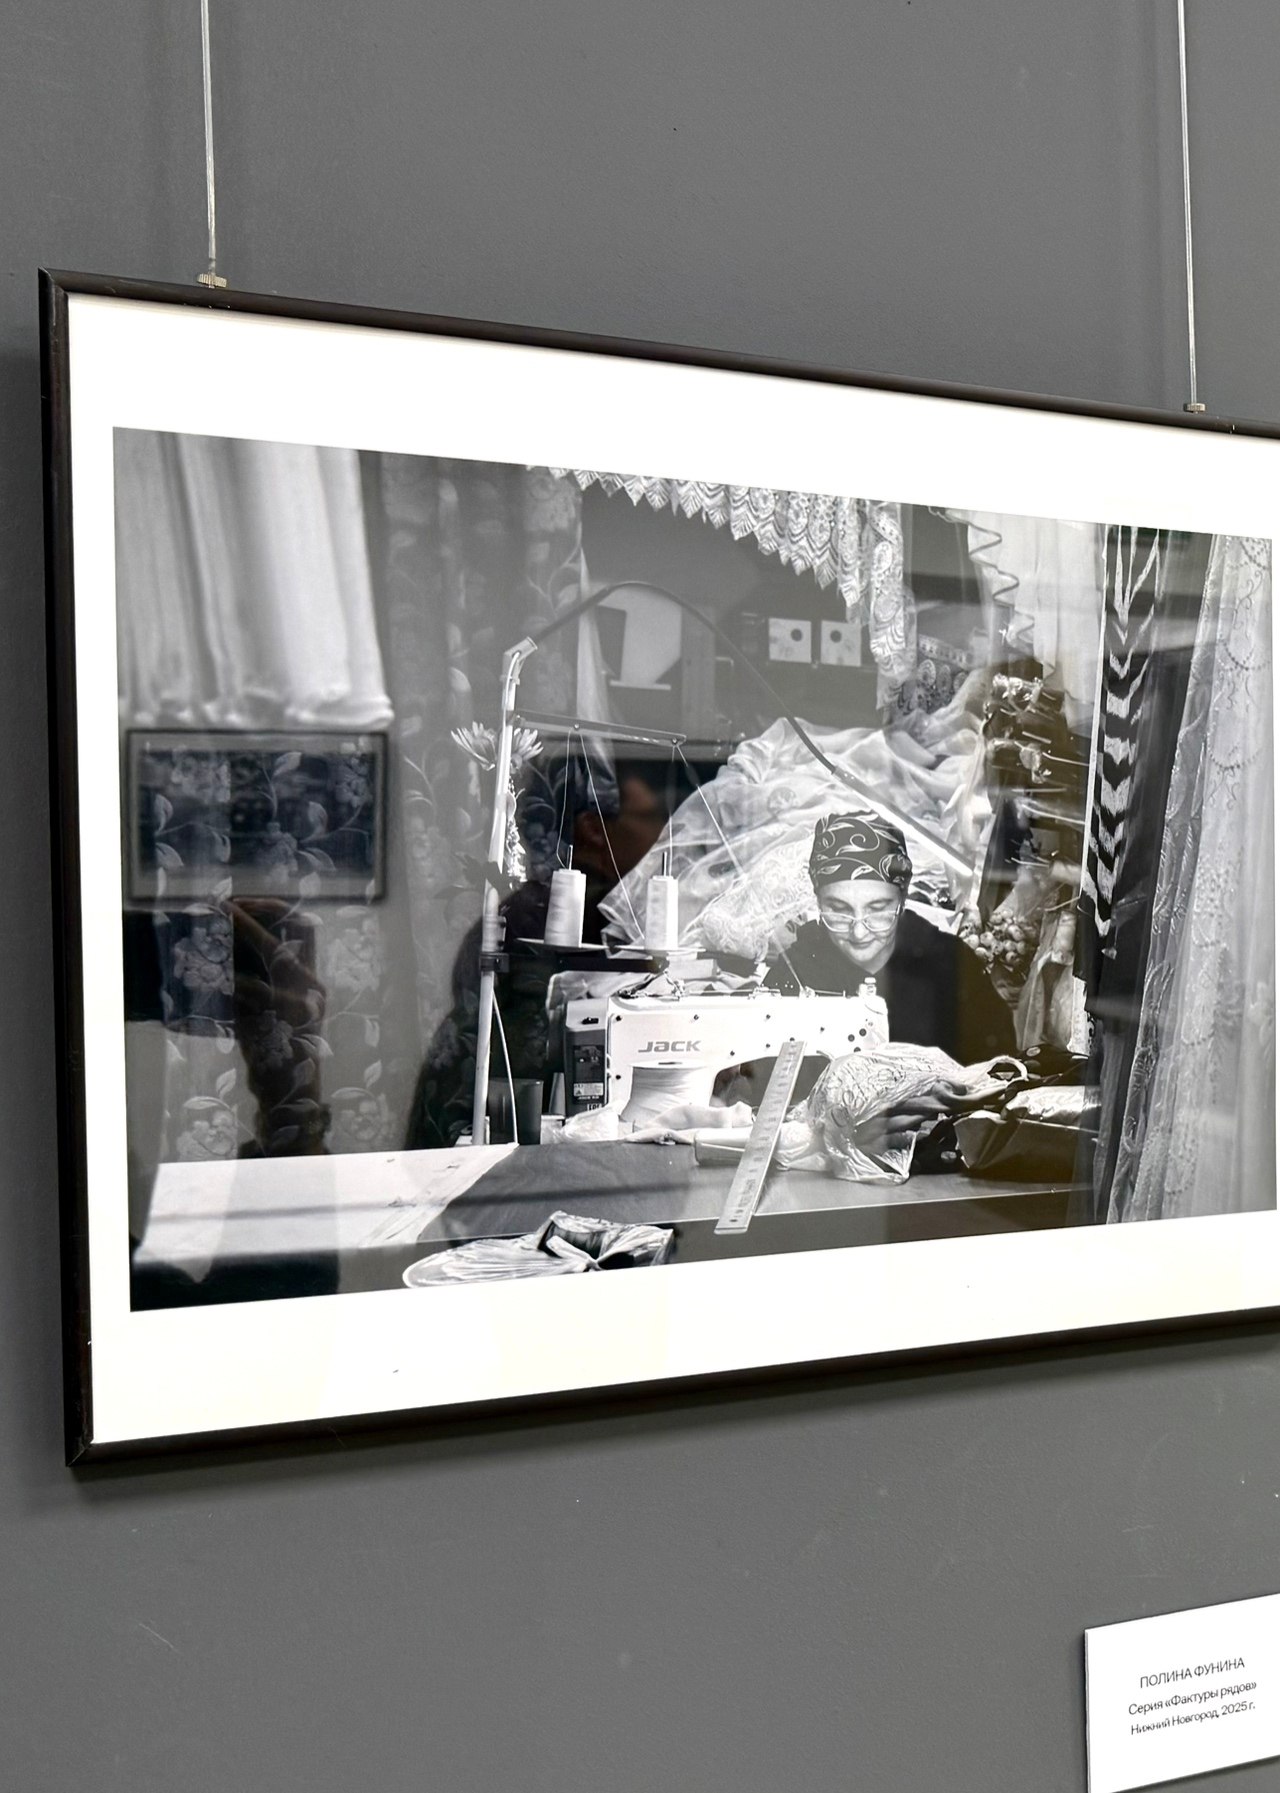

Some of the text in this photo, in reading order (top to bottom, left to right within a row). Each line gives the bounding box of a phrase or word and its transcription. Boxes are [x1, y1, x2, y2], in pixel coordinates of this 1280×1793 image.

[1140, 1657, 1245, 1688] ПОЛИНА ФУНИНА
[1128, 1681, 1257, 1716] Серия «Фактуры рядов»
[1130, 1718, 1170, 1735] Нижний
[1172, 1709, 1219, 1727] Новгород,
[1221, 1700, 1248, 1715] 2025
